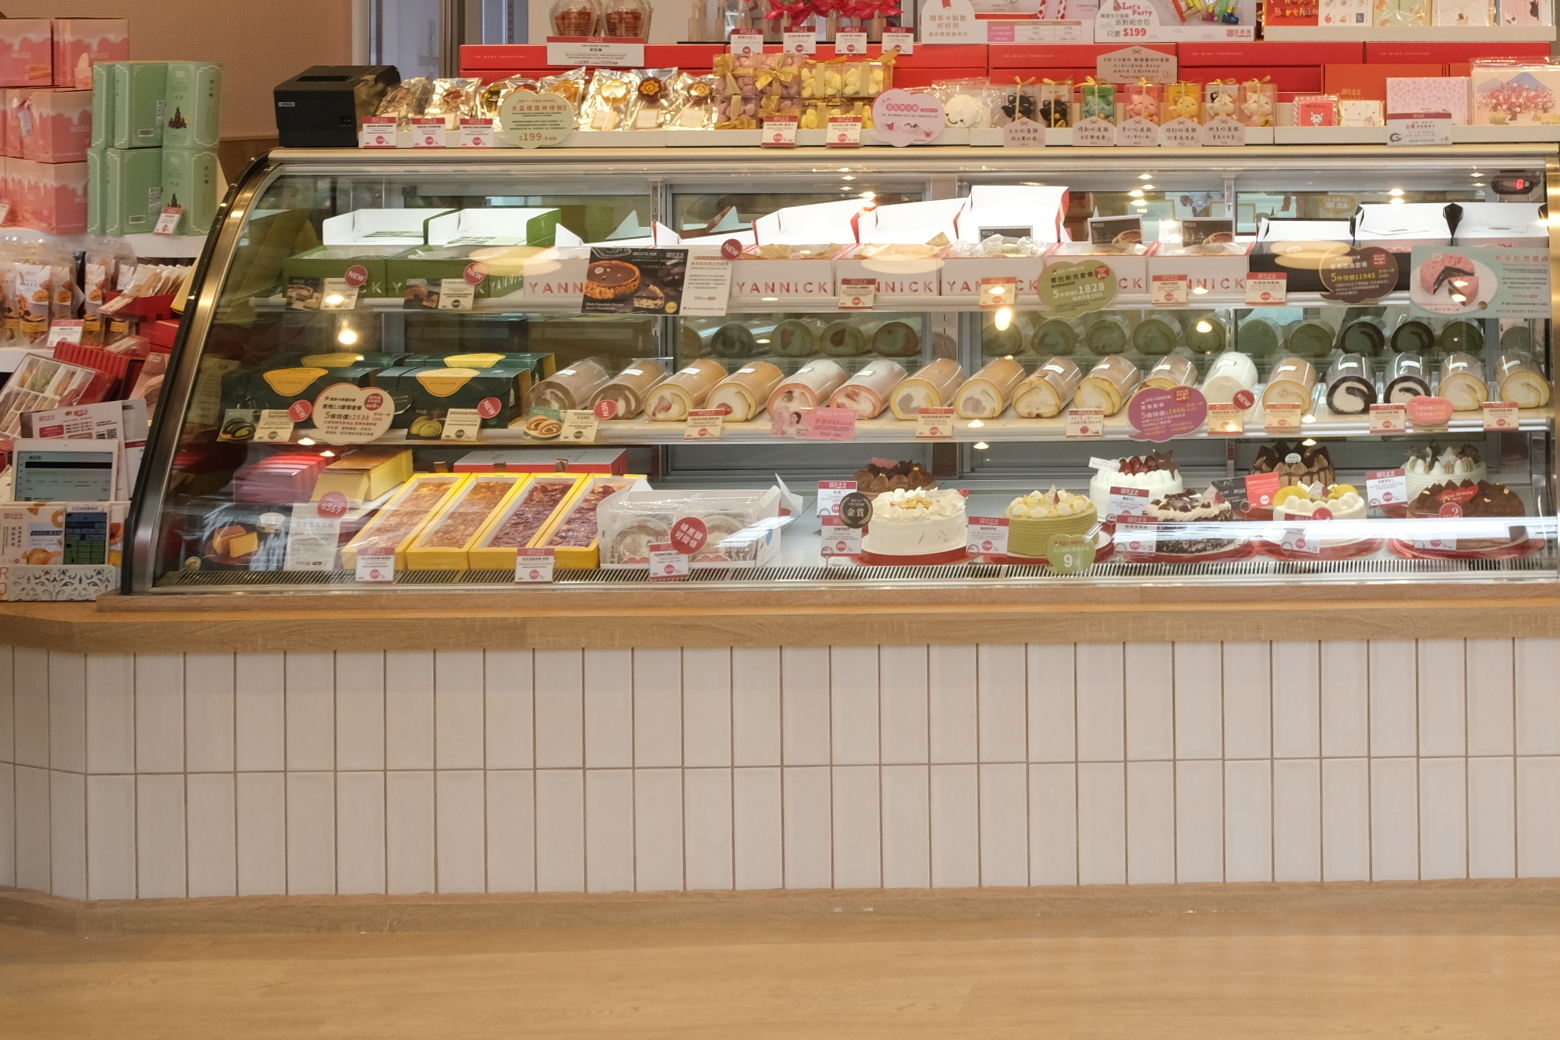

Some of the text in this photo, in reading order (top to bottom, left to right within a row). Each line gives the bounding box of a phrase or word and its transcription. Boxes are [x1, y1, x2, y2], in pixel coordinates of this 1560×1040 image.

[1121, 2, 1141, 11] Let's
[1132, 9, 1153, 18] Party
[1115, 19, 1150, 27] 派對組合包
[1106, 27, 1147, 38] 只要 $199
[723, 244, 740, 256] NEW
[348, 271, 366, 281] NEW
[467, 268, 483, 280] NEW
[736, 281, 828, 294] YANNICK
[946, 279, 1039, 293] YANCK
[1235, 392, 1253, 408] NEW
[293, 403, 308, 420] NEW
[481, 400, 498, 416] NEW
[601, 402, 610, 418] NEW
[1456, 490, 1474, 498] Birthday
[321, 502, 342, 514] $369
[847, 508, 865, 517] 金賞
[679, 522, 704, 540] 補差額
[675, 530, 698, 549] 可提領
